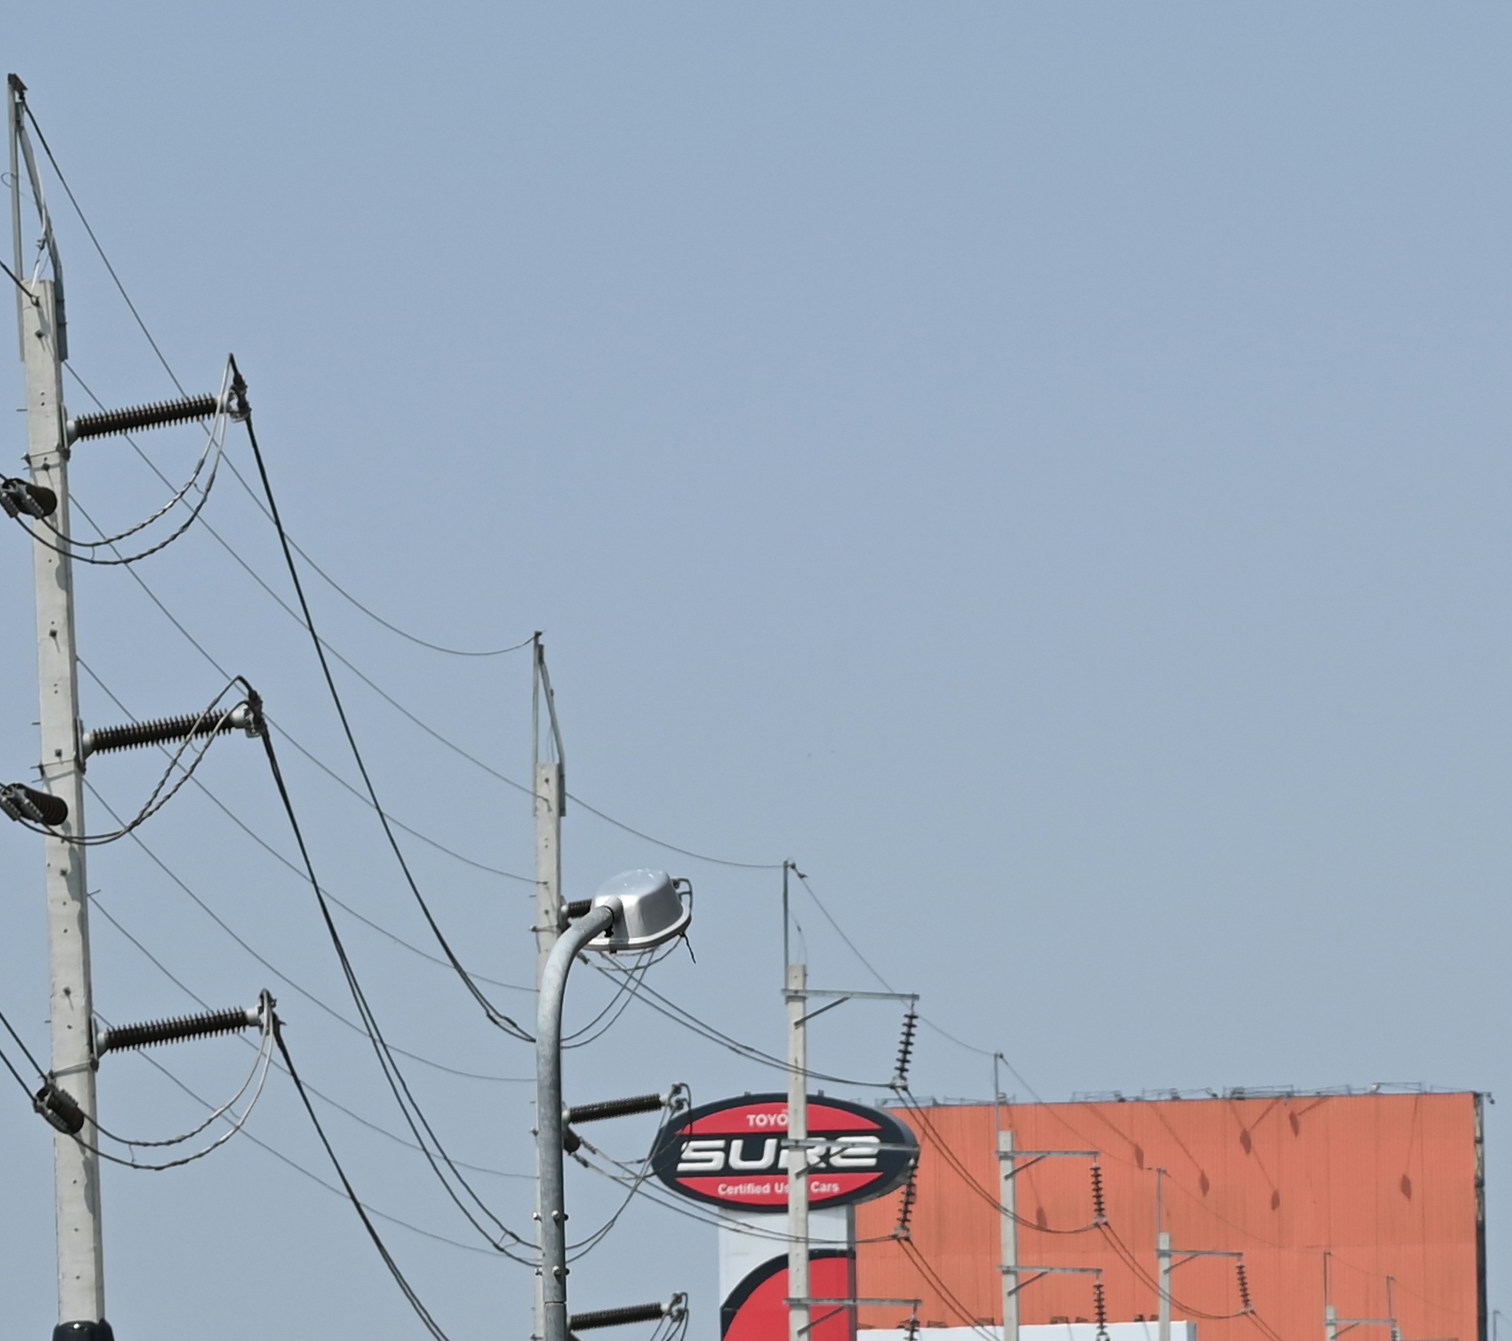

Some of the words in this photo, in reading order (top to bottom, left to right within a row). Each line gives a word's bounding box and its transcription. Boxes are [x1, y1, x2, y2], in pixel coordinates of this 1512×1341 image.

[747, 1114, 789, 1127] TOYO
[677, 1136, 881, 1171] SURE
[718, 1183, 770, 1196] Certified
[810, 1181, 840, 1193] Cars
